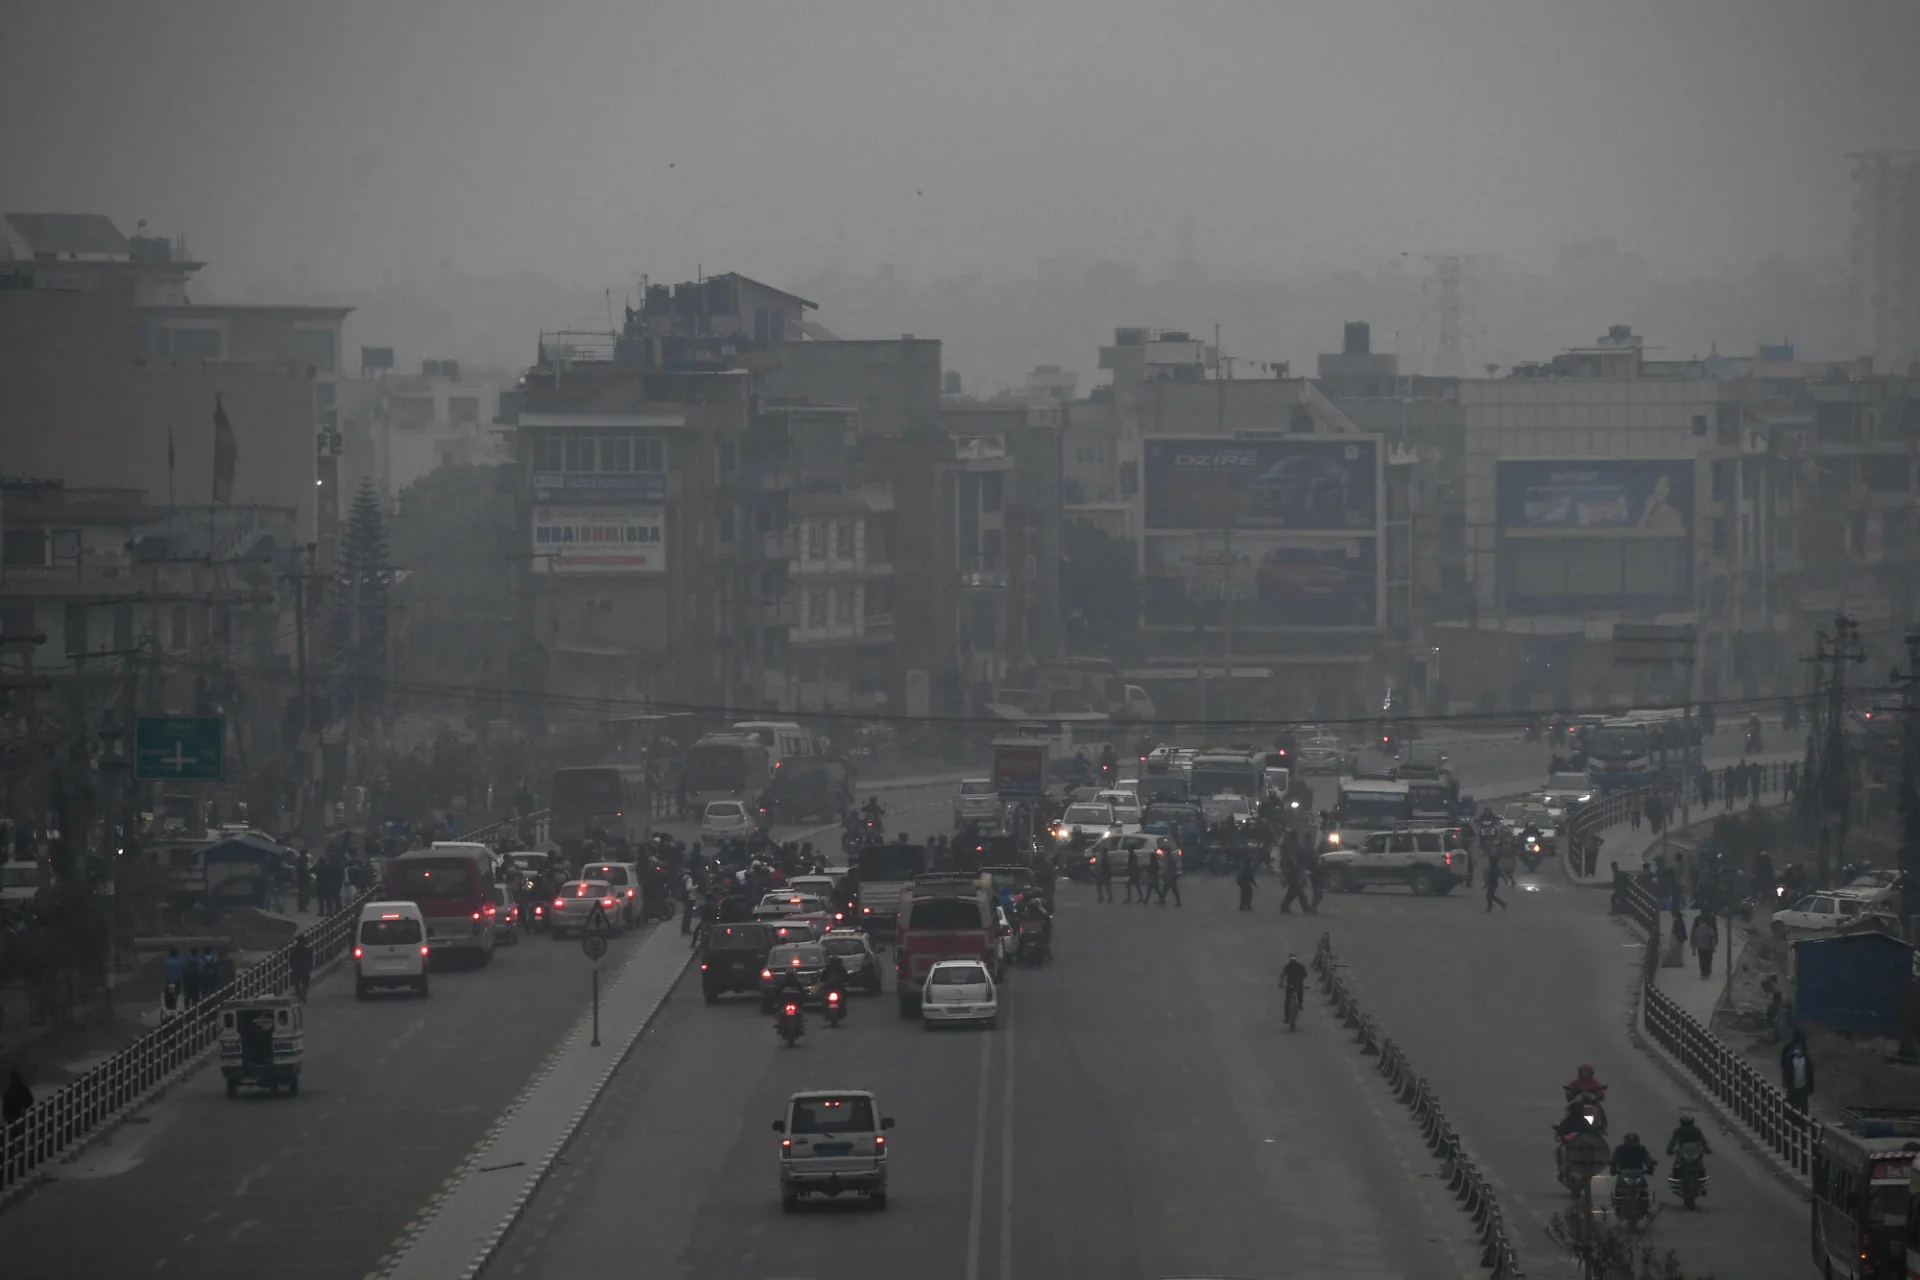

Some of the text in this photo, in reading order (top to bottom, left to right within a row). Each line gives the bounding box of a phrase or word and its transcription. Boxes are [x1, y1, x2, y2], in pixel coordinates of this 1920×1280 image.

[1173, 453, 1258, 466] DZIRE
[536, 526, 574, 543] MBA
[626, 526, 661, 543] BBA
